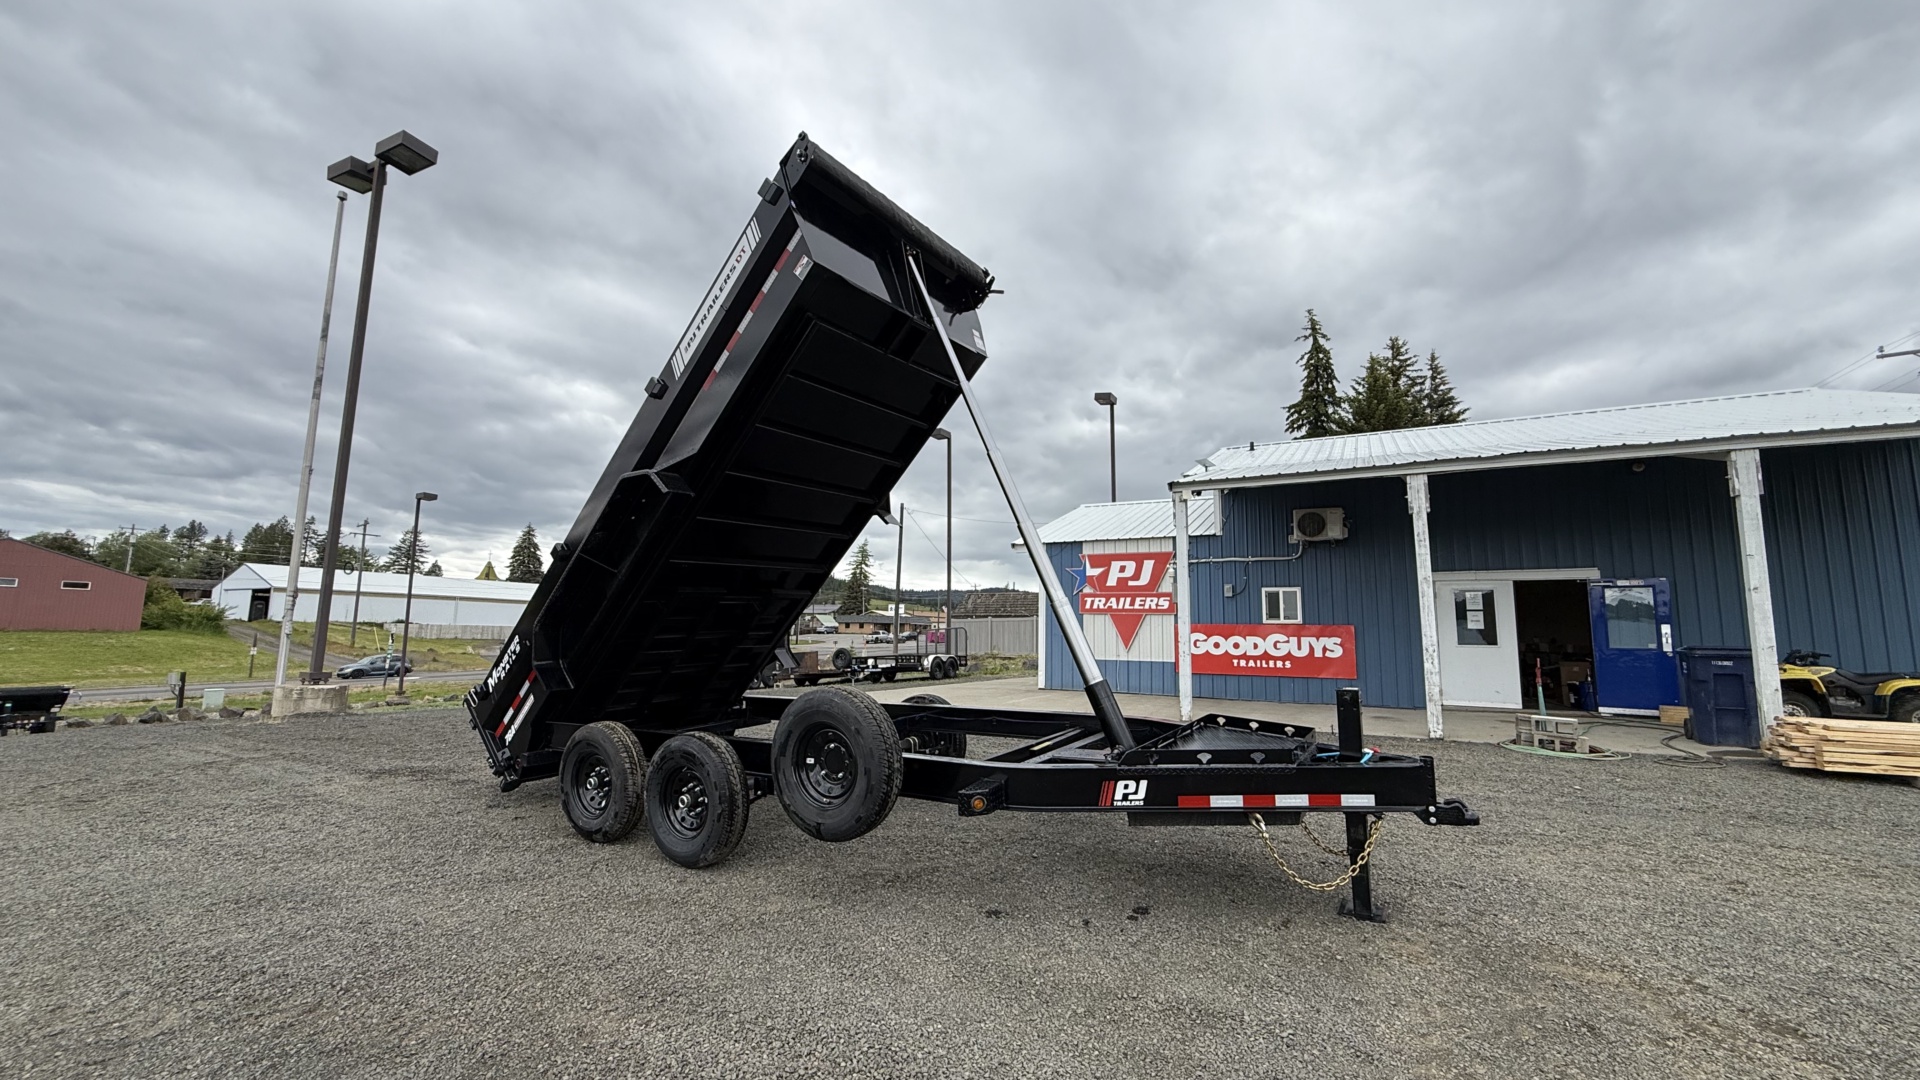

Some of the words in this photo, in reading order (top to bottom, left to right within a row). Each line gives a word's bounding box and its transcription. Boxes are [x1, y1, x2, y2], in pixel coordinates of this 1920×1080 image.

[735, 245, 746, 264] DT
[1106, 560, 1155, 586] PJ
[1084, 597, 1170, 610] TRAILERS
[1190, 632, 1343, 658] GOODGUYS
[500, 643, 520, 680] RAILS
[1232, 659, 1292, 669] TRAILERS
[1114, 780, 1148, 800] PJ
